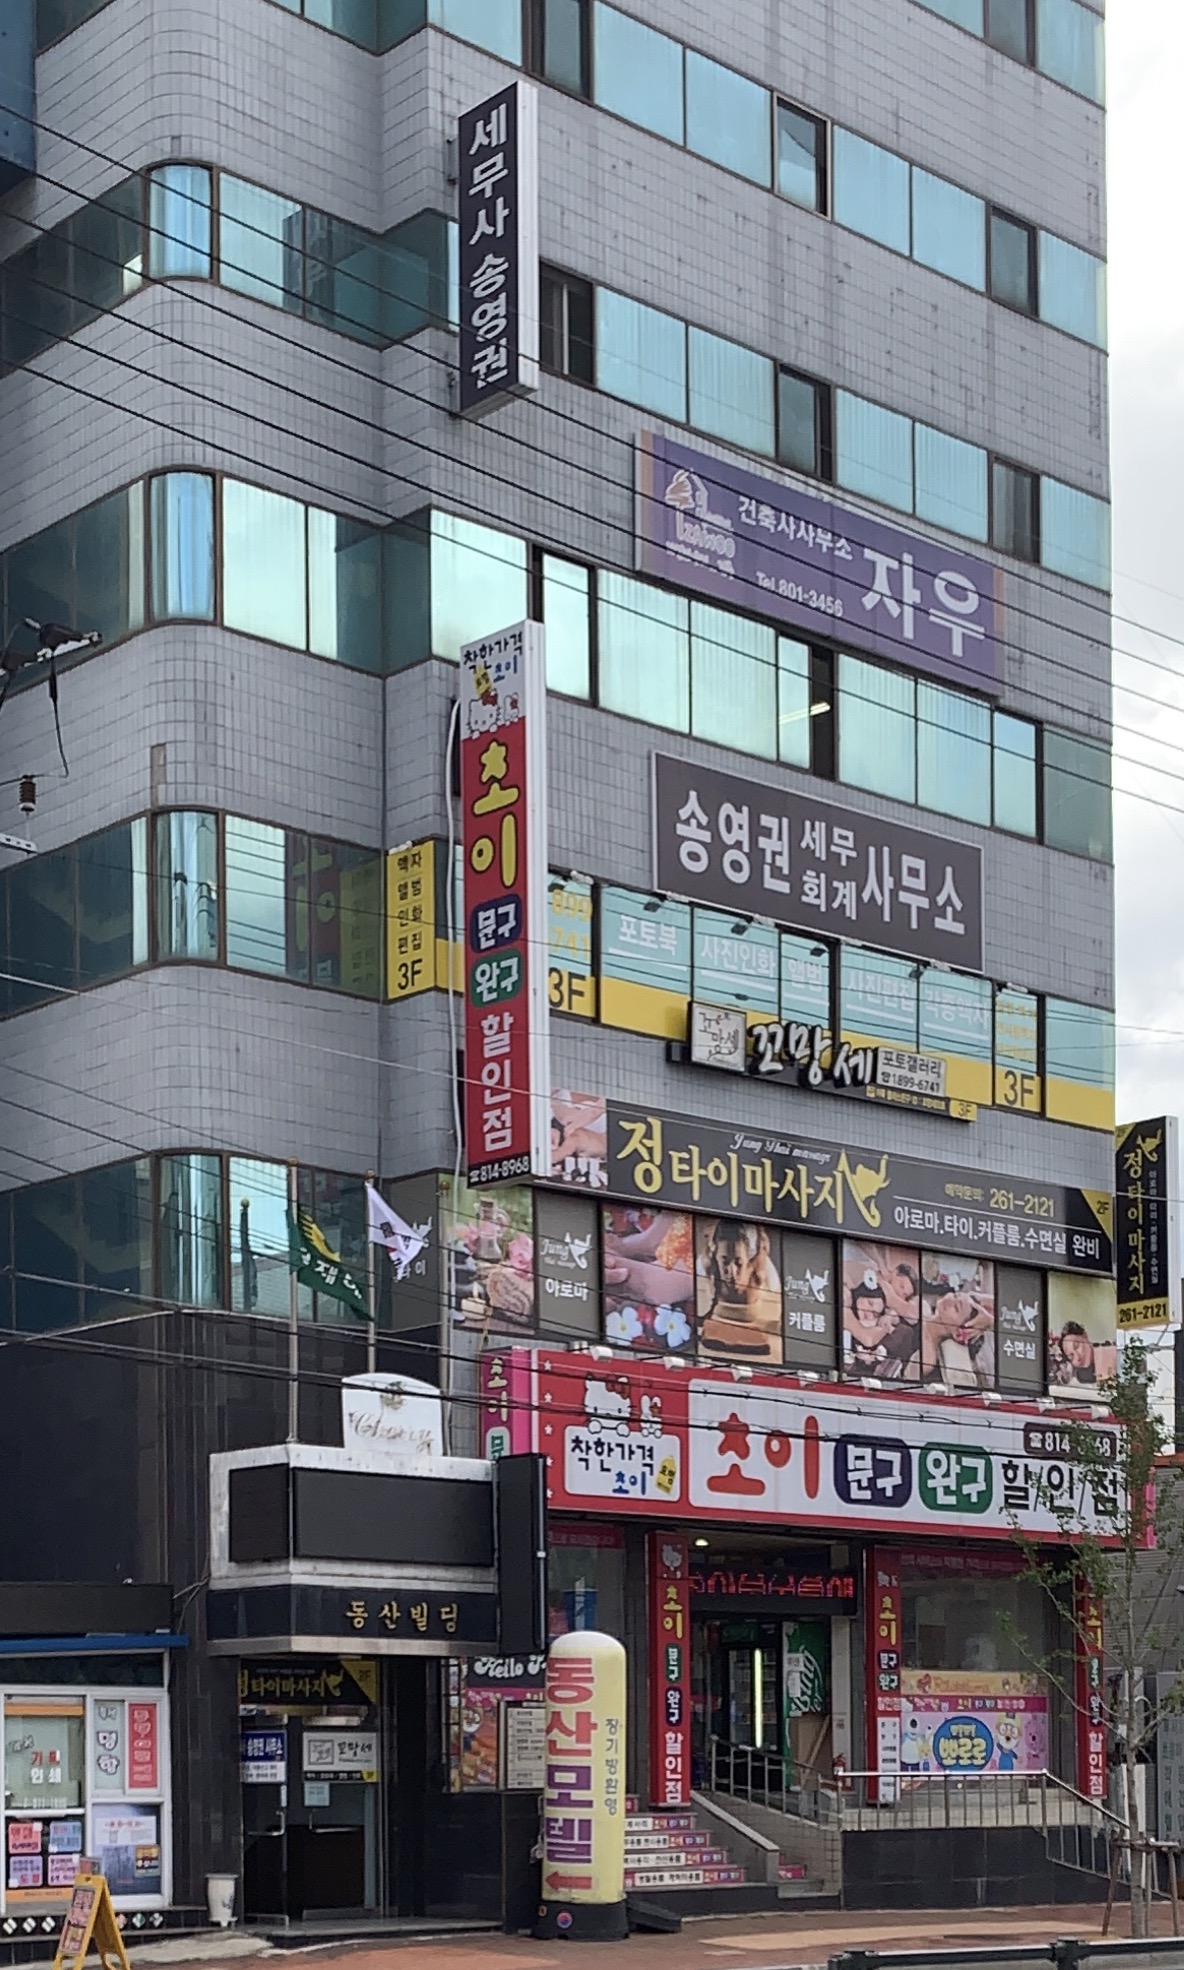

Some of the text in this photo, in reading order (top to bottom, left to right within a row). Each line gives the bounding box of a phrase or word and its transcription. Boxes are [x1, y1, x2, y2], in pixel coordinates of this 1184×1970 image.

[469, 102, 510, 390] 세무사 송영권
[756, 571, 843, 618] Tel.801-3456
[861, 546, 986, 658] 자우
[463, 631, 523, 675] 착한가격
[493, 654, 518, 684] 초이
[471, 738, 520, 889] 초이
[675, 790, 791, 894] 송영권
[800, 819, 858, 867] 세무
[800, 869, 857, 921] 회계
[861, 845, 966, 936] 사무소
[477, 902, 517, 951] 문구
[617, 914, 678, 956] 포토북
[397, 958, 423, 991] 3F
[700, 935, 777, 978] 사진인화
[474, 956, 519, 1003] 완구
[548, 967, 587, 1011] 3F
[480, 1011, 515, 1152] 할인점
[1003, 1070, 1035, 1108] 3F
[479, 1155, 530, 1183] 814-8968
[989, 1187, 1054, 1218] 261-2121
[1071, 1234, 1100, 1260] 완비
[545, 1278, 588, 1301] 아로마
[788, 1311, 826, 1333] 커플룸
[1119, 1302, 1168, 1324] 261-2121
[1003, 1339, 1036, 1360] 수면실
[571, 1435, 654, 1477] 착한가격
[705, 1412, 820, 1500] 초이
[846, 1444, 903, 1500] 문구
[925, 1450, 988, 1506] 완구
[1001, 1459, 1118, 1516] 할인점
[612, 1470, 647, 1496] 초이
[345, 1600, 459, 1633] 동산빌딩
[663, 1584, 684, 1639] 초이
[879, 1595, 897, 1646] 초이
[546, 1657, 598, 1864] 동산모텔
[665, 1730, 684, 1804] 할인점
